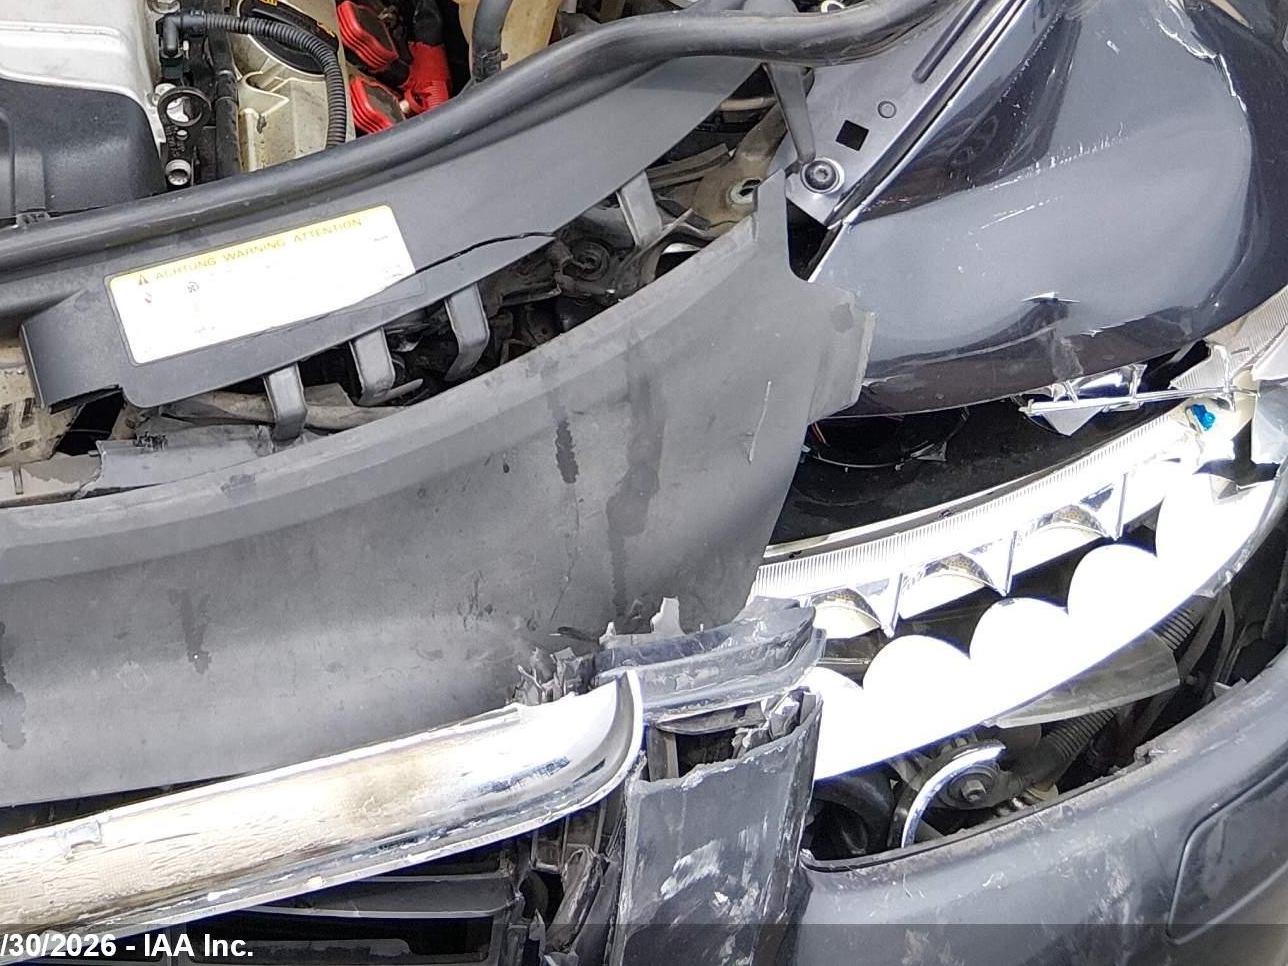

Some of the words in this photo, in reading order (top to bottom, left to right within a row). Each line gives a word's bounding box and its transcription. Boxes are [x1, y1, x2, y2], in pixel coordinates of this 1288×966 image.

[155, 257, 217, 280] ACHTUNG
[222, 240, 286, 262] WARNING
[293, 218, 362, 243] ATTENTION
